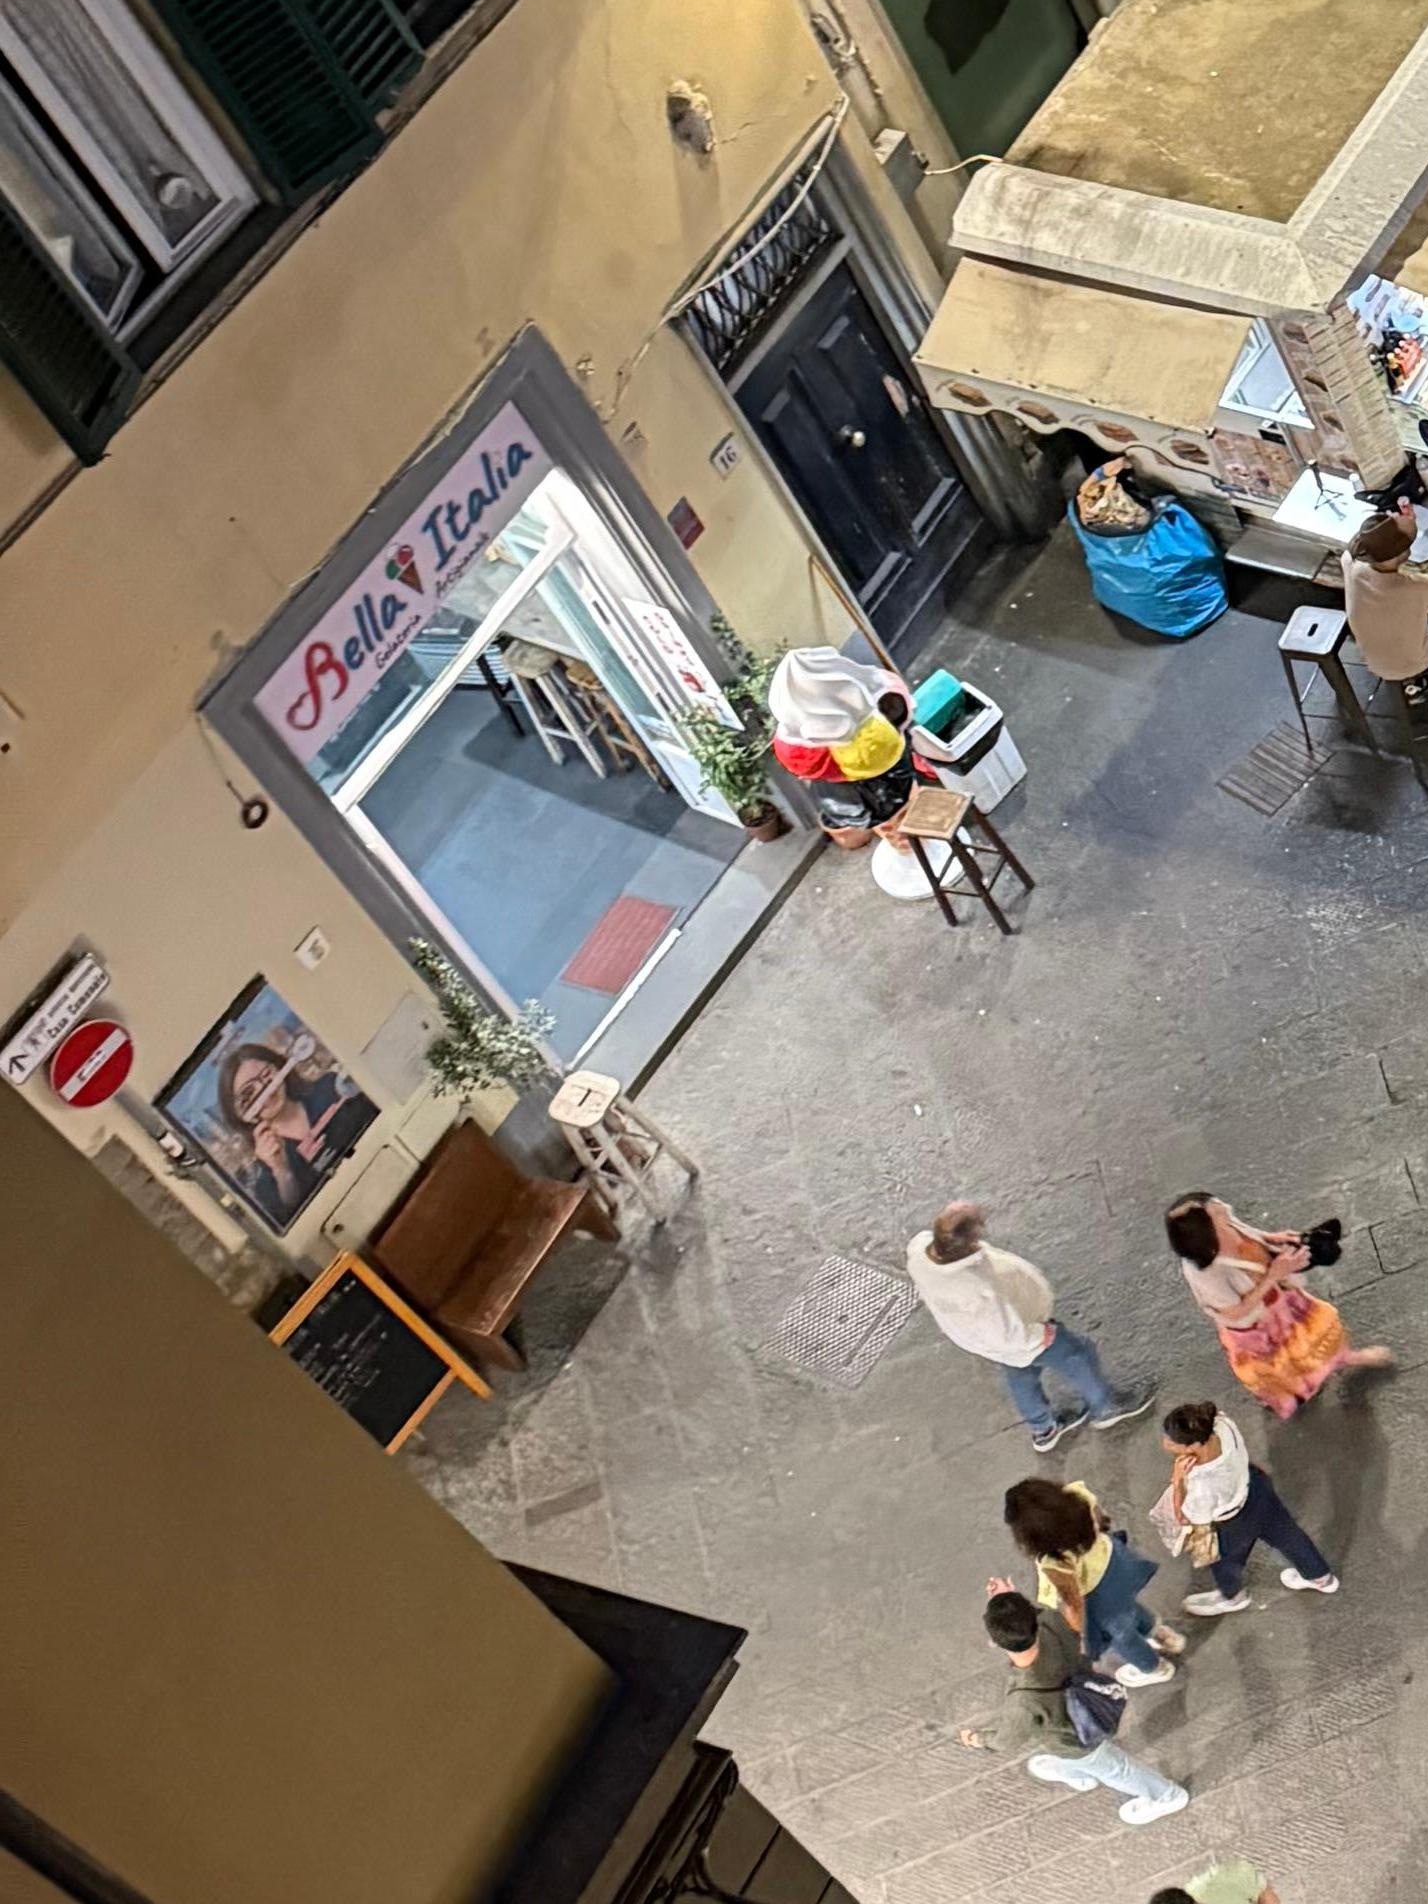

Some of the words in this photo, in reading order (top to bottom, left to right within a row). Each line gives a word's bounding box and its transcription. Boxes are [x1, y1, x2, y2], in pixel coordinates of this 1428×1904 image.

[719, 446, 737, 470] 16
[285, 593, 408, 732] Bella
[420, 441, 533, 572] Italia
